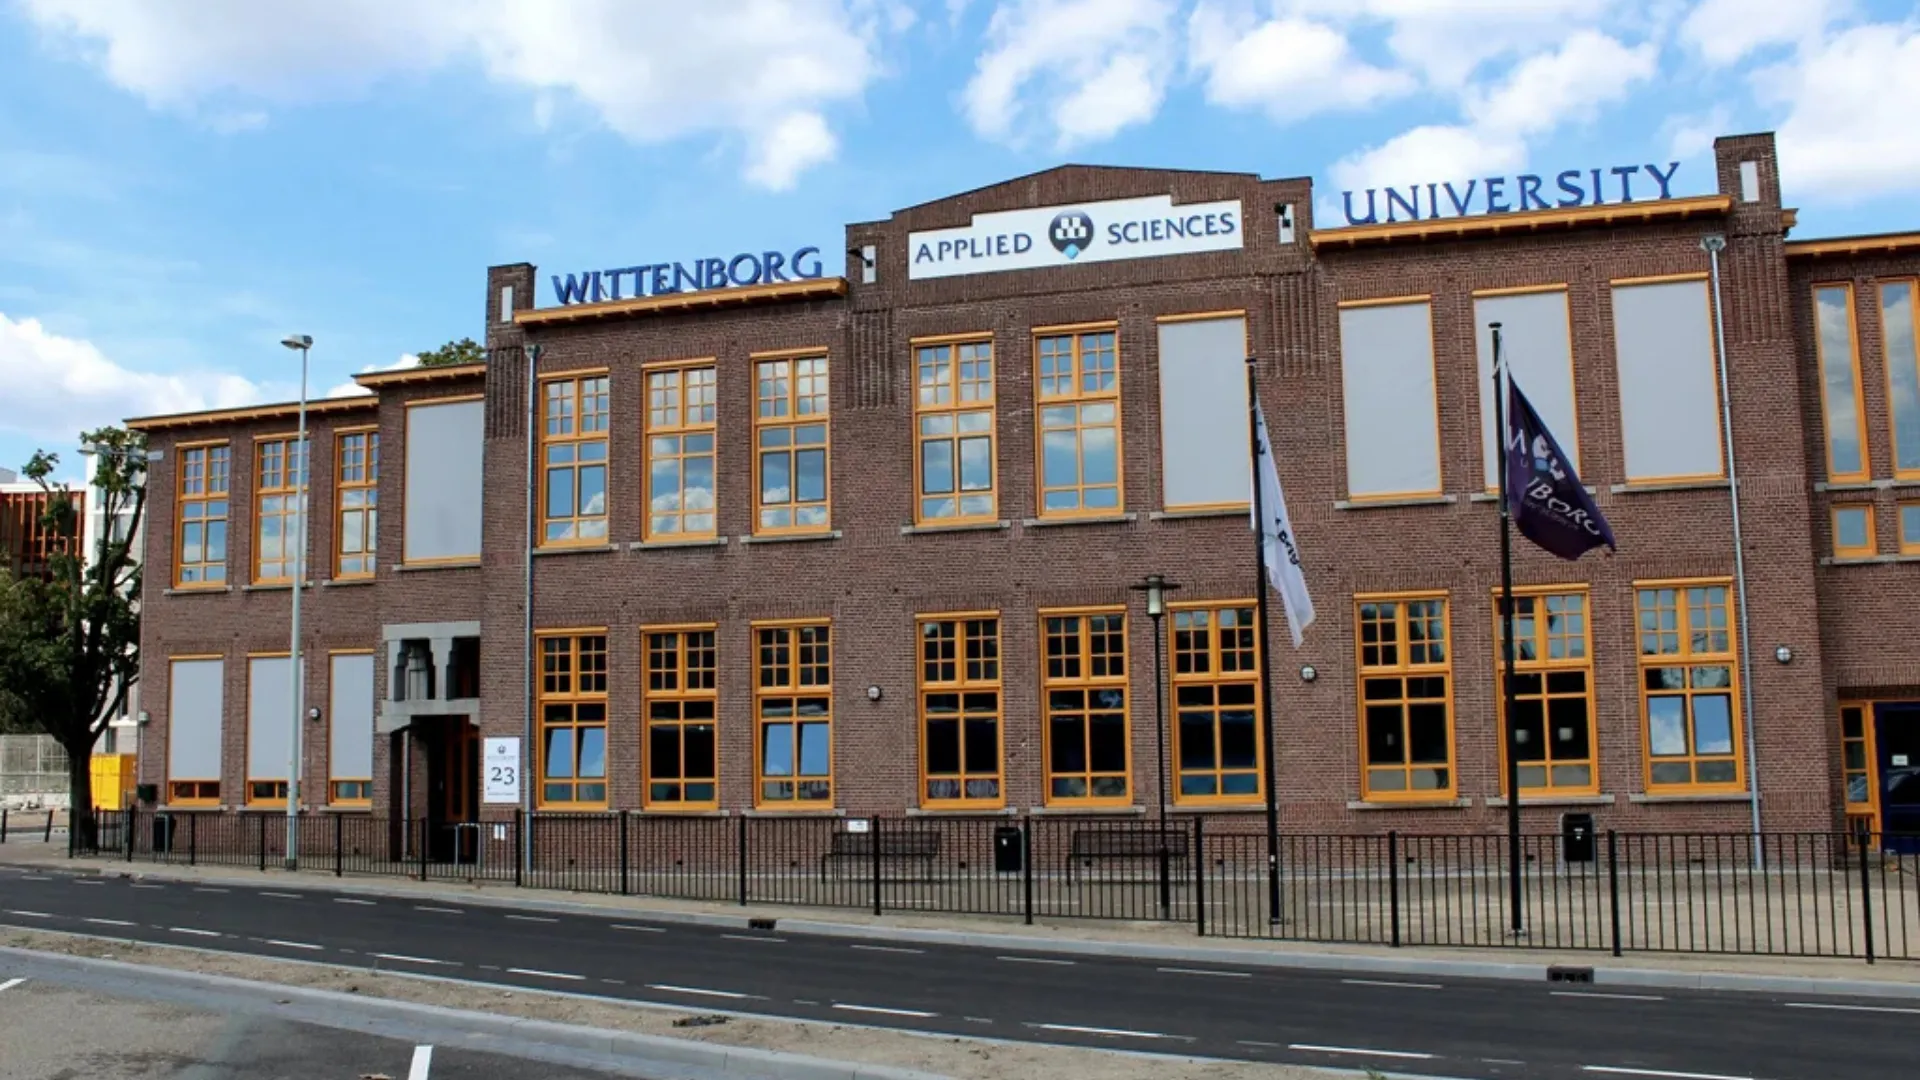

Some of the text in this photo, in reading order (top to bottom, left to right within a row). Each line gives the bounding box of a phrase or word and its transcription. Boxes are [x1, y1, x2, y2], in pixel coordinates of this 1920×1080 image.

[1342, 161, 1681, 226] UNIVERSITY
[915, 212, 1236, 264] APPLIED SCIENCES
[551, 247, 823, 305] WITTENBORG
[491, 766, 515, 786] 23
